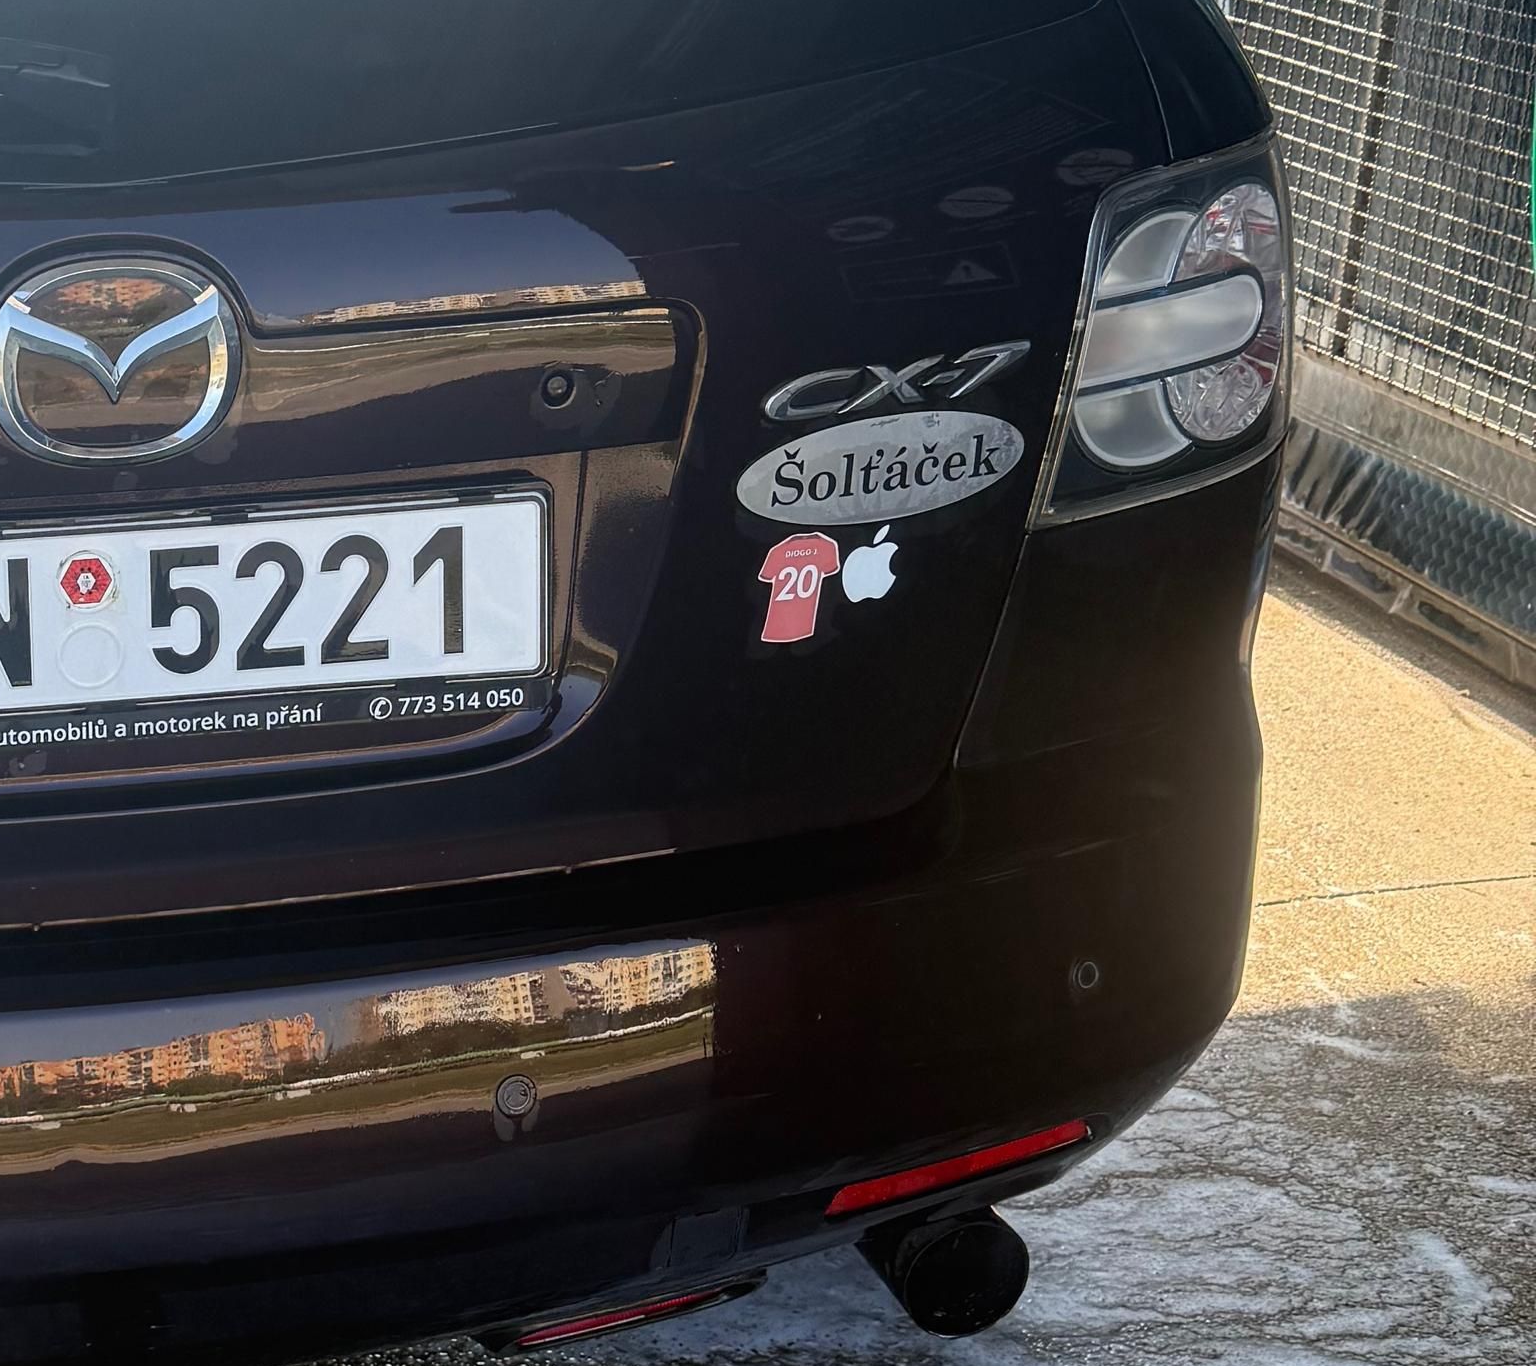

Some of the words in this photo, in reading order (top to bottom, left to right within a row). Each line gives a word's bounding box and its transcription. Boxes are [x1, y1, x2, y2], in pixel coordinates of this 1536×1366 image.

[770, 434, 1003, 508] Šolťáček
[148, 524, 467, 675] 5221
[774, 564, 819, 602] 20
[114, 723, 128, 739] a
[133, 711, 227, 737] motorek
[233, 713, 260, 730] na
[265, 702, 324, 731] přání
[398, 695, 437, 716] 773
[441, 691, 481, 712] 514
[485, 687, 524, 709] 050
